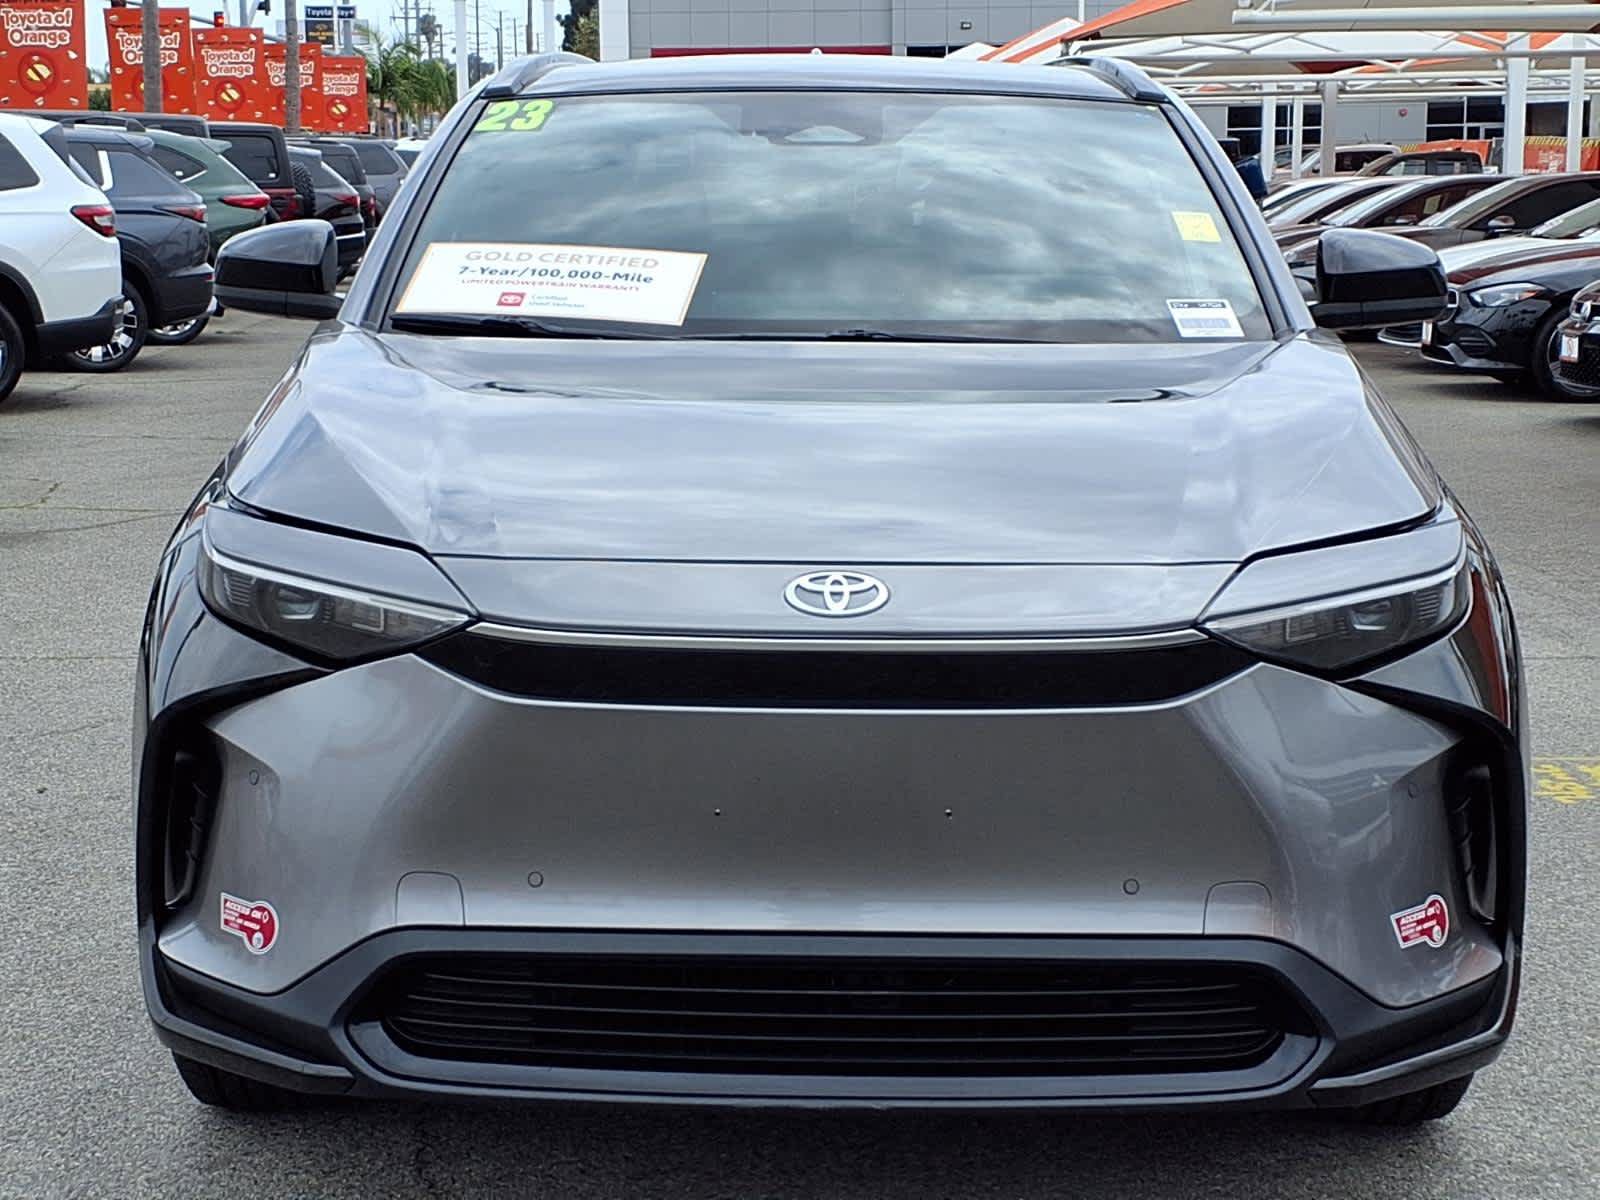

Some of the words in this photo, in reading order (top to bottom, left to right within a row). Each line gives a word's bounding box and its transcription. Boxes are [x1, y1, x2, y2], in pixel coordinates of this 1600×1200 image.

[1, 9, 54, 29] Toyota
[54, 8, 72, 26] of
[307, 8, 332, 18] Toyota
[8, 28, 70, 48] Orange
[162, 32, 179, 48] of
[123, 49, 178, 65] Orge
[202, 49, 240, 64] Toyota
[241, 48, 255, 62] of
[207, 64, 253, 78] Orange
[301, 61, 314, 74] of
[322, 73, 347, 85] oyota
[474, 100, 553, 132] 23
[465, 250, 533, 262] GOLD
[538, 253, 659, 269] CERTIFIED
[459, 265, 653, 284] 7-Year/100,000-Mile
[506, 280, 578, 288] POWERTRAIN
[579, 282, 640, 292] WARRANTY
